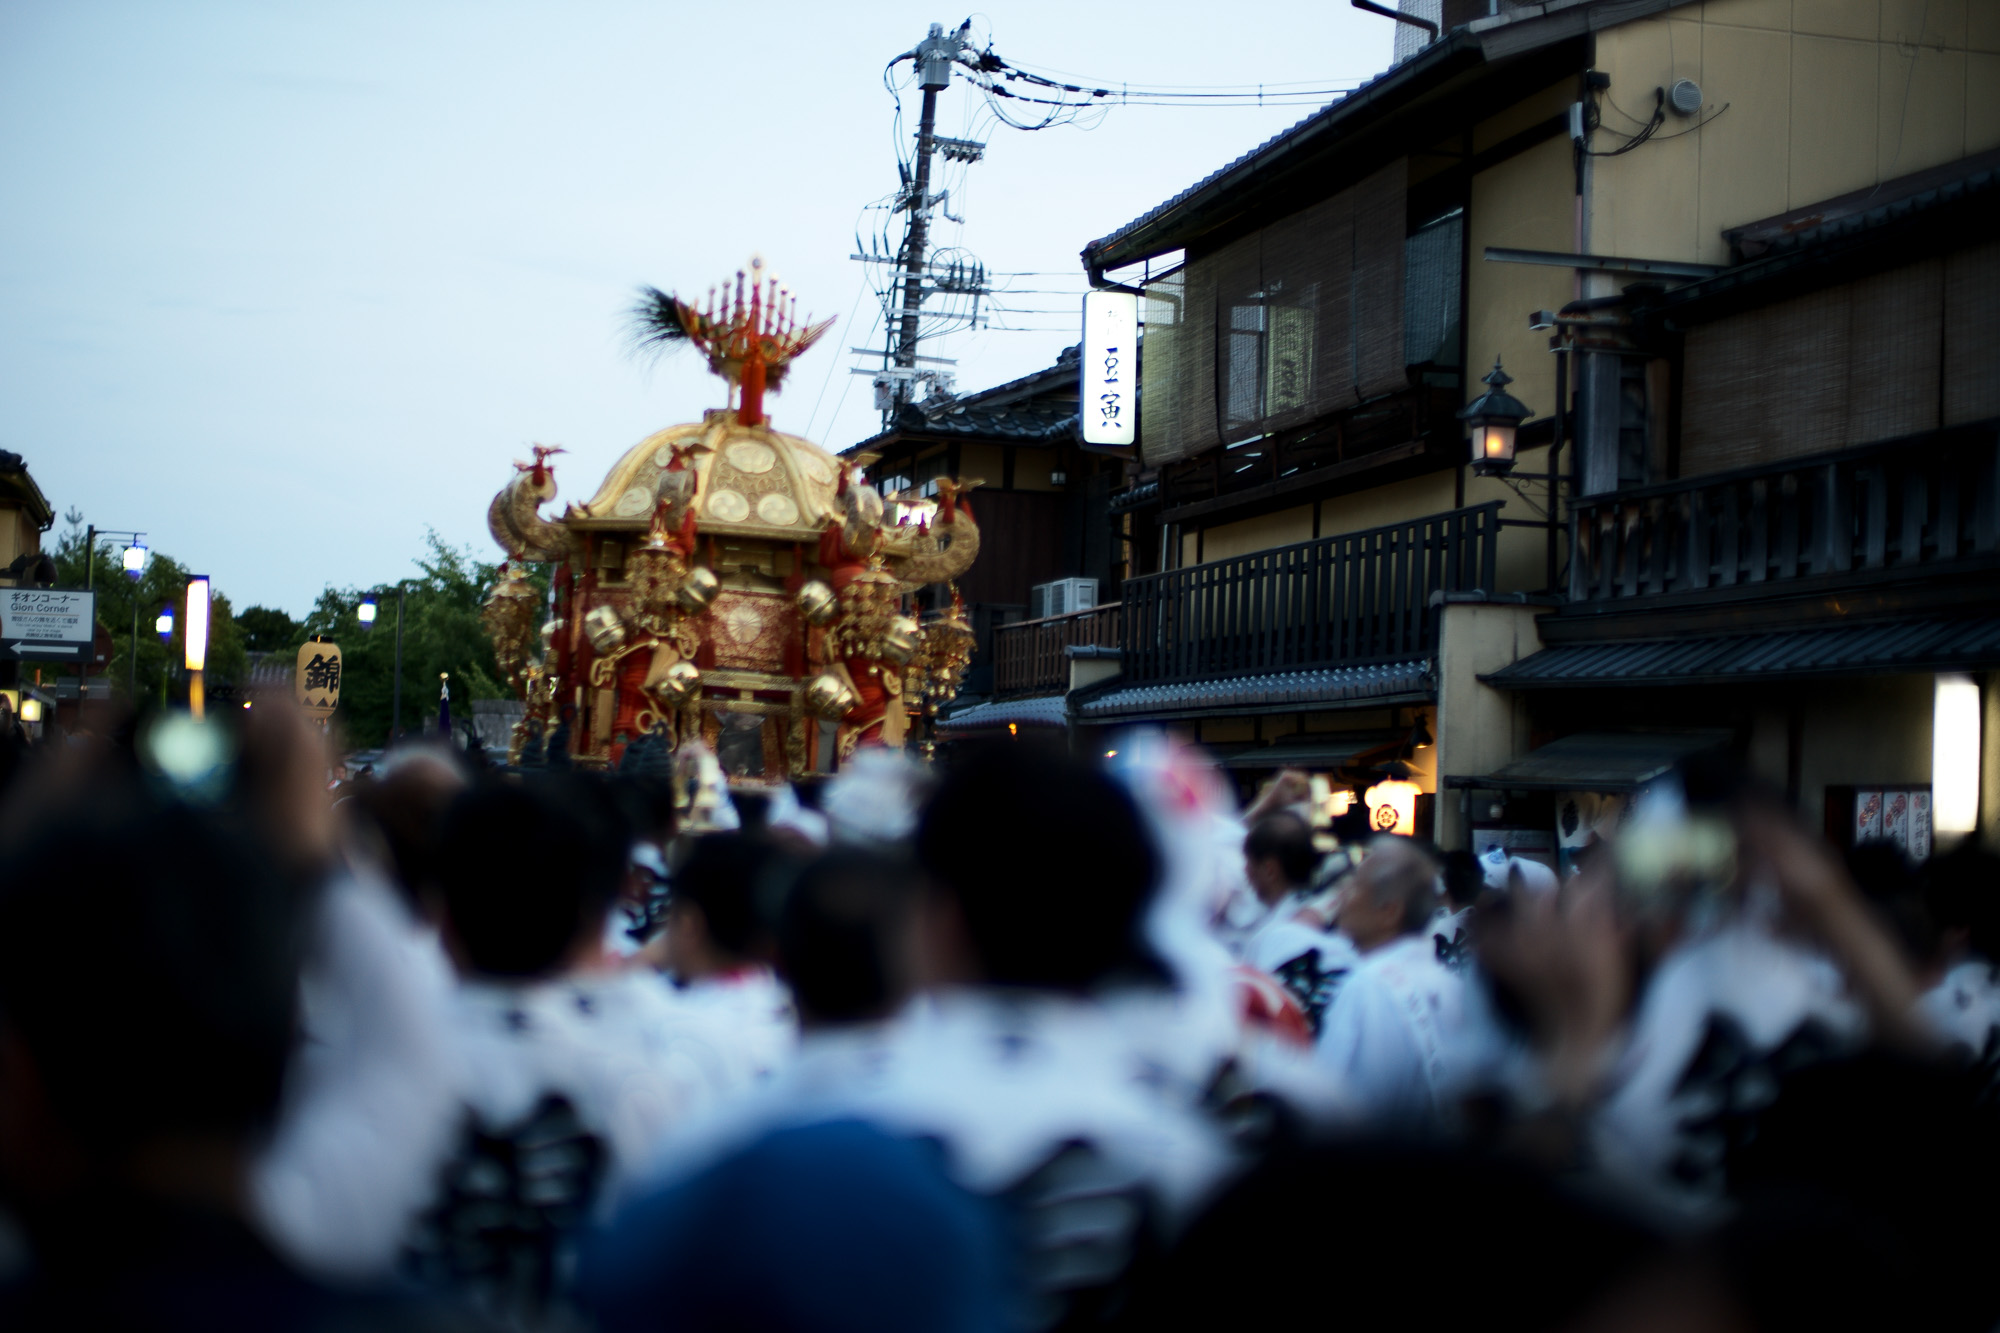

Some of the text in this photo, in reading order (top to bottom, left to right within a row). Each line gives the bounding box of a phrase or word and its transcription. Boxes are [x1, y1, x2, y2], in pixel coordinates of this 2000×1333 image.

[1100, 347, 1122, 428] 豆寅
[11, 592, 80, 603] ギオンコーナー
[11, 603, 70, 613] Gion Corner
[304, 653, 340, 693] 錦
